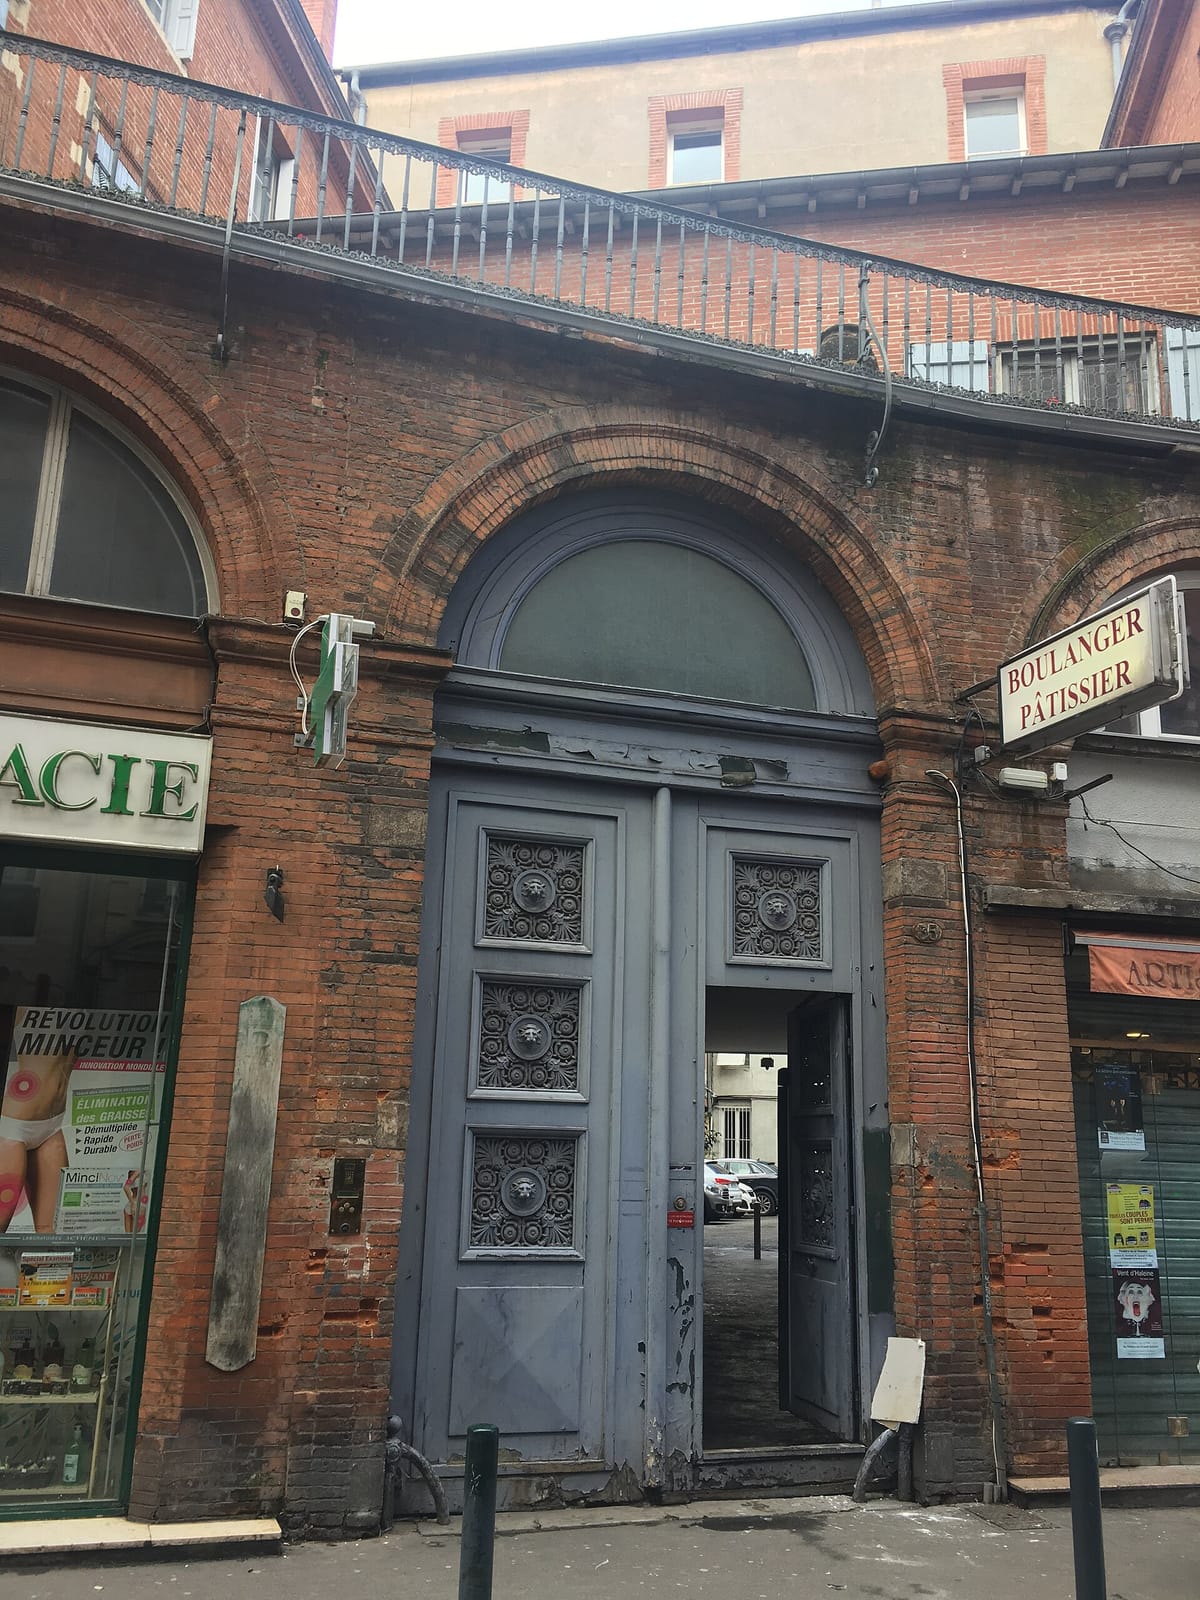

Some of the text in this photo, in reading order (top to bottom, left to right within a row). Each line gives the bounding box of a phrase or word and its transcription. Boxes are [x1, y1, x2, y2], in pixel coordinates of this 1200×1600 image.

[1008, 607, 1144, 696] BOULANGER
[1020, 660, 1133, 731] PÂTISSIER
[0, 743, 199, 821] ACIE
[22, 1007, 168, 1033] RÉVOLUTION
[18, 1032, 148, 1059] MINCEUR
[79, 1062, 125, 1071] INNOVATION
[76, 1113, 96, 1123] des
[84, 1123, 138, 1135] Démultipliée
[84, 1135, 114, 1146] Rapide
[84, 1145, 118, 1155] Durable
